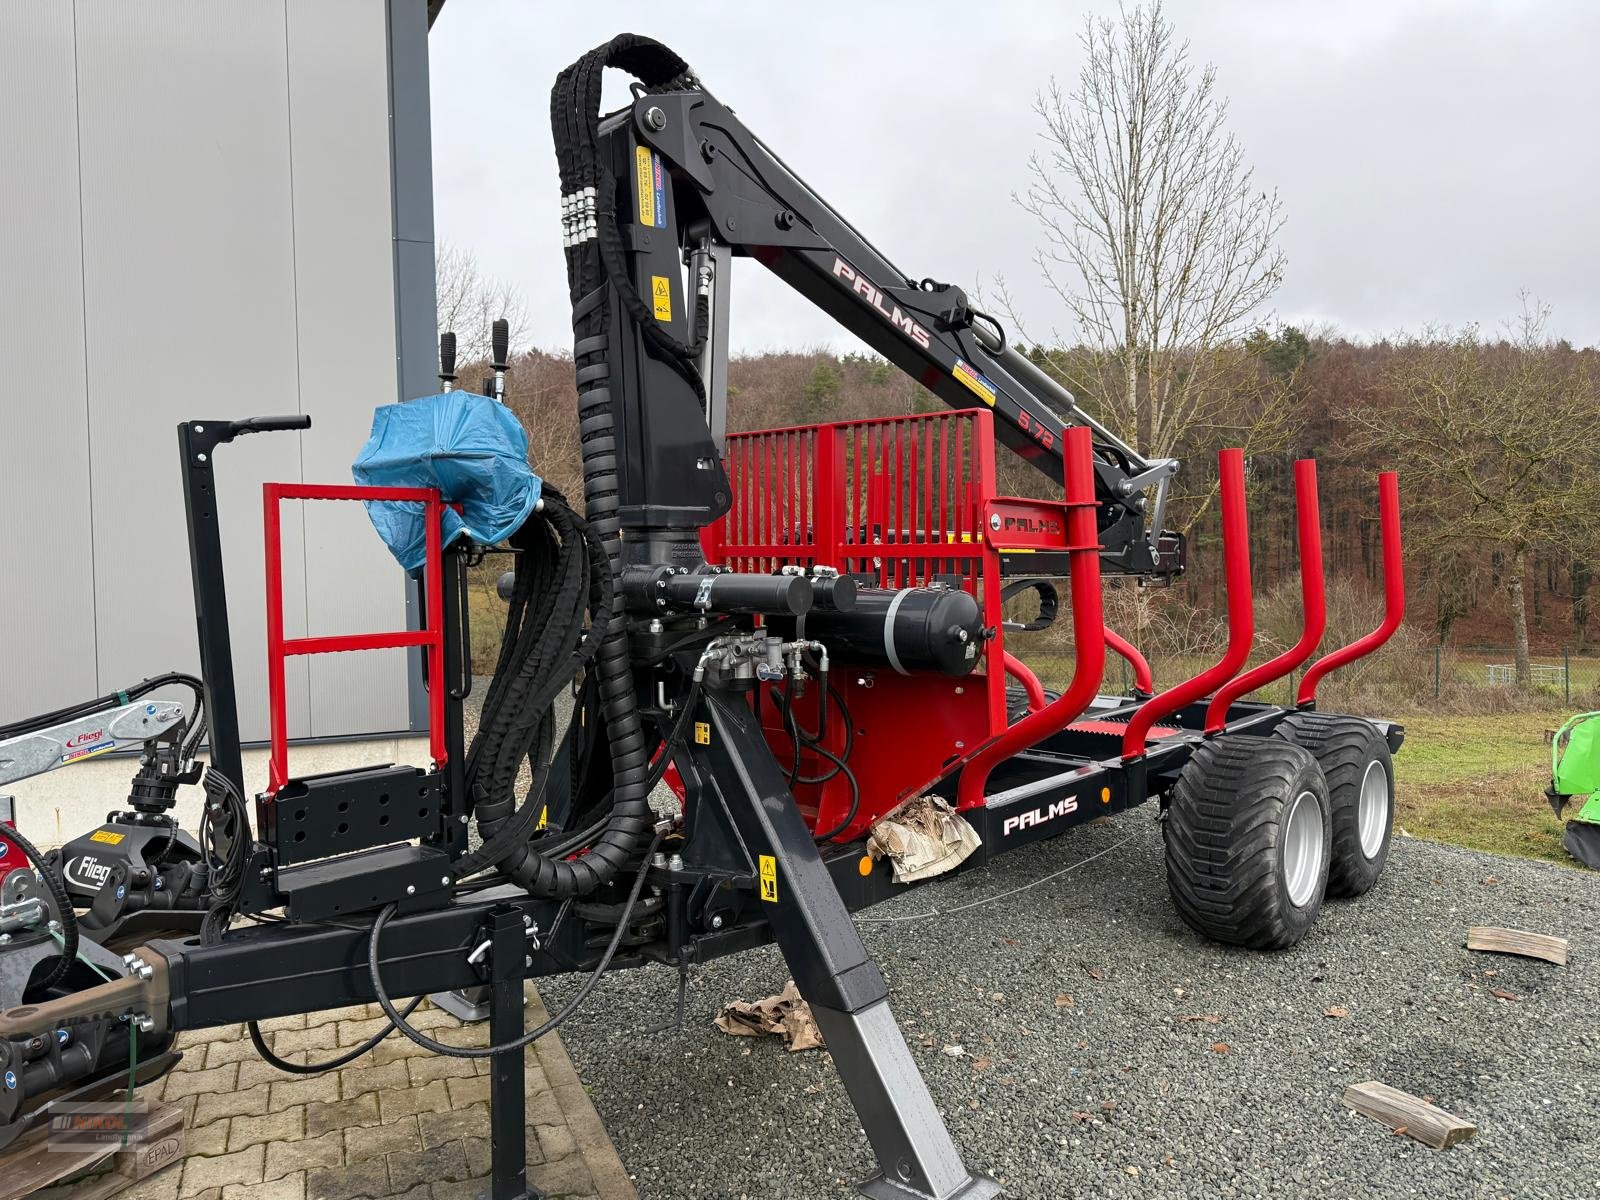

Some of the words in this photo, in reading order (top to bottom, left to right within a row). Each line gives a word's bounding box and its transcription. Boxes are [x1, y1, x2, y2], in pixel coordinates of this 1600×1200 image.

[833, 257, 930, 349] PALMS
[1017, 409, 1055, 450] 5.72
[1004, 517, 1060, 534] PALMS
[78, 729, 103, 742] Fliegl
[1003, 794, 1078, 837] PALMS
[77, 856, 111, 886] Flieg
[147, 1142, 175, 1165] EPAL
